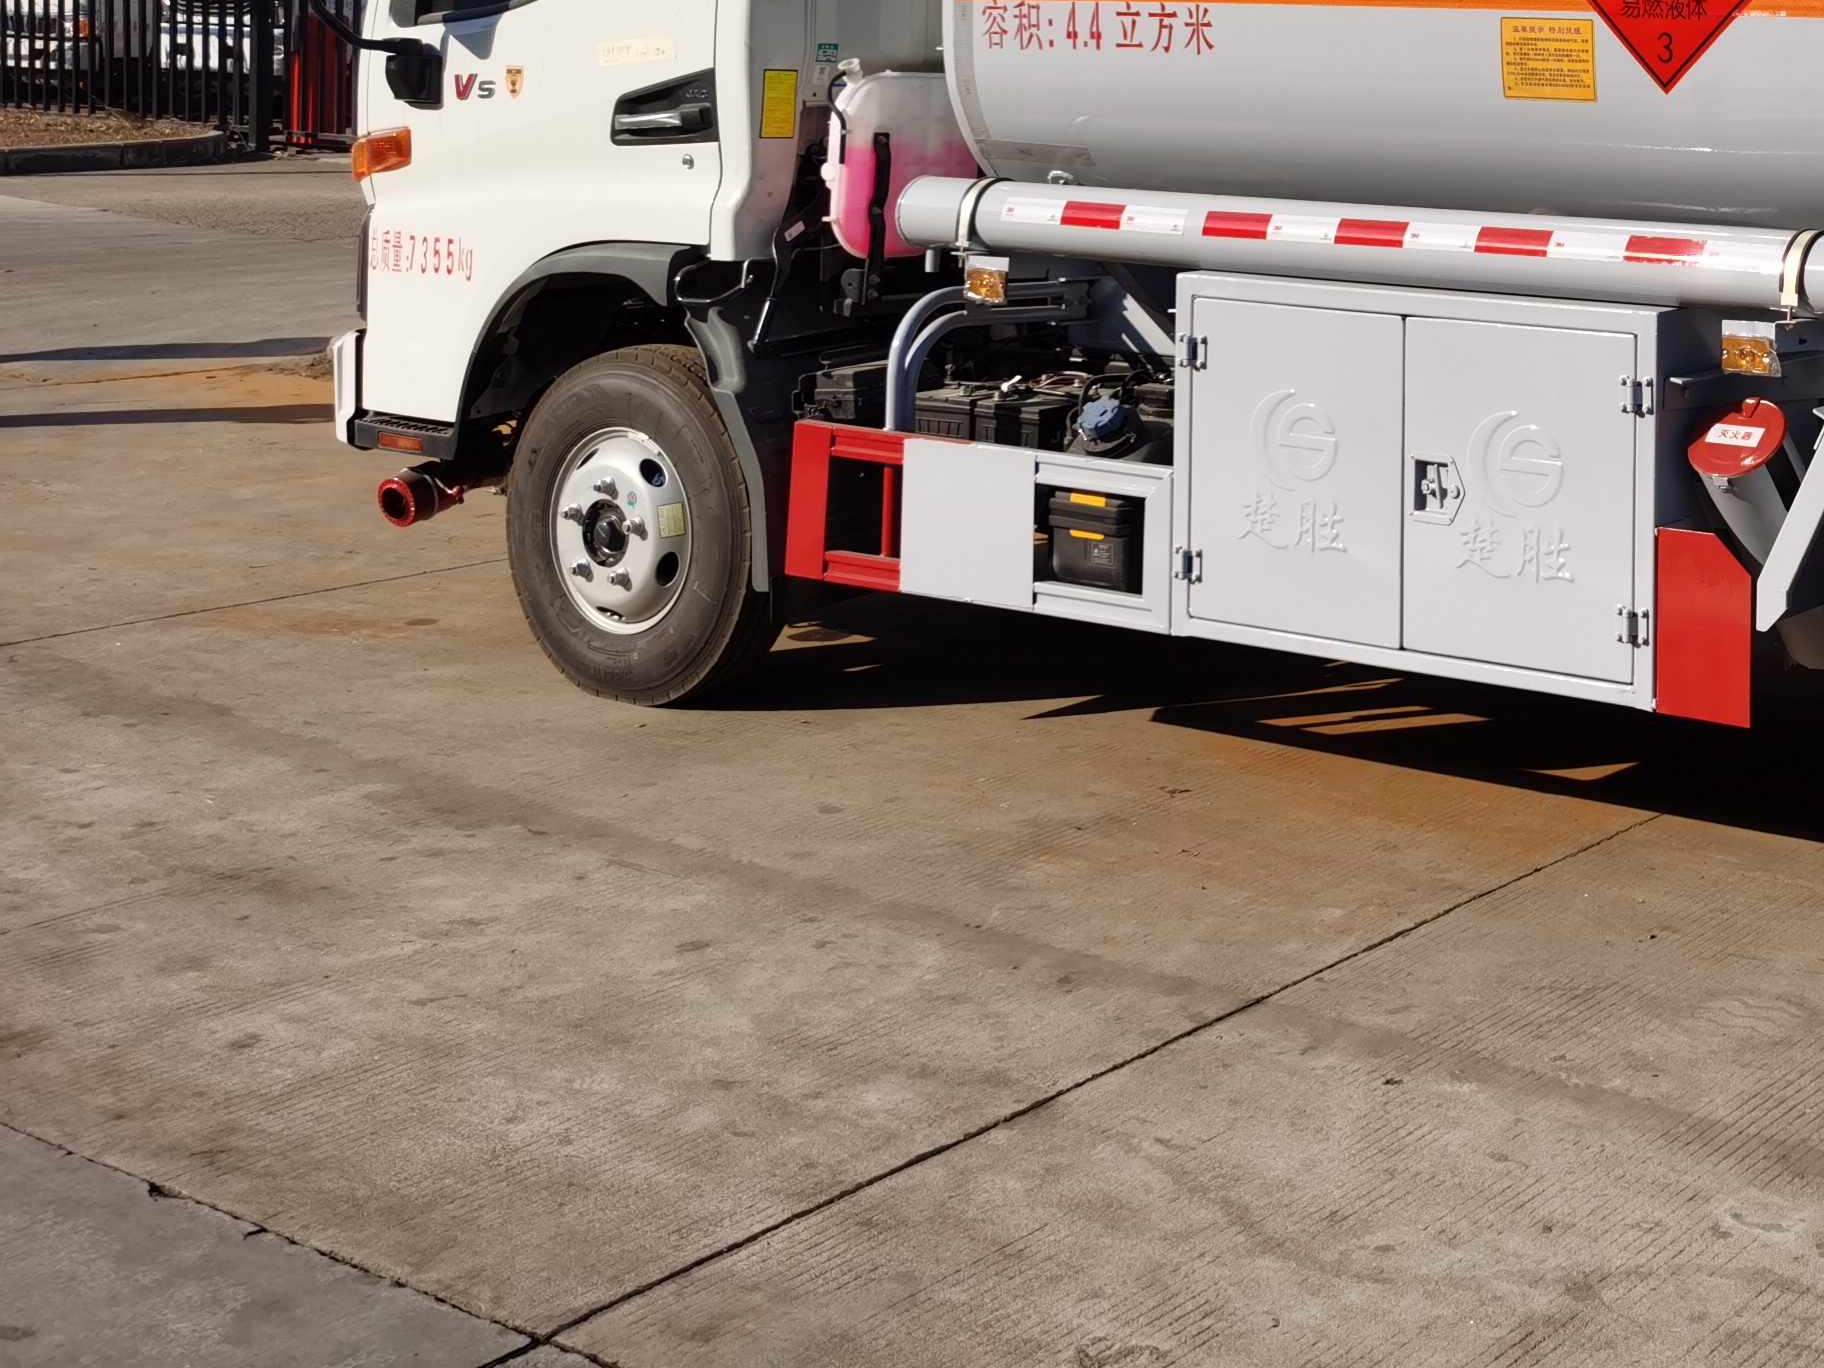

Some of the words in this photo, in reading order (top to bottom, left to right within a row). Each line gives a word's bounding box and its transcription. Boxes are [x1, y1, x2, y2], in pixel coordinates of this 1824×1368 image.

[1657, 32, 1674, 64] 3
[1718, 429, 1753, 440] 灭火器
[1237, 492, 1348, 554] 楚胜
[1454, 518, 1575, 583] 楚胜
